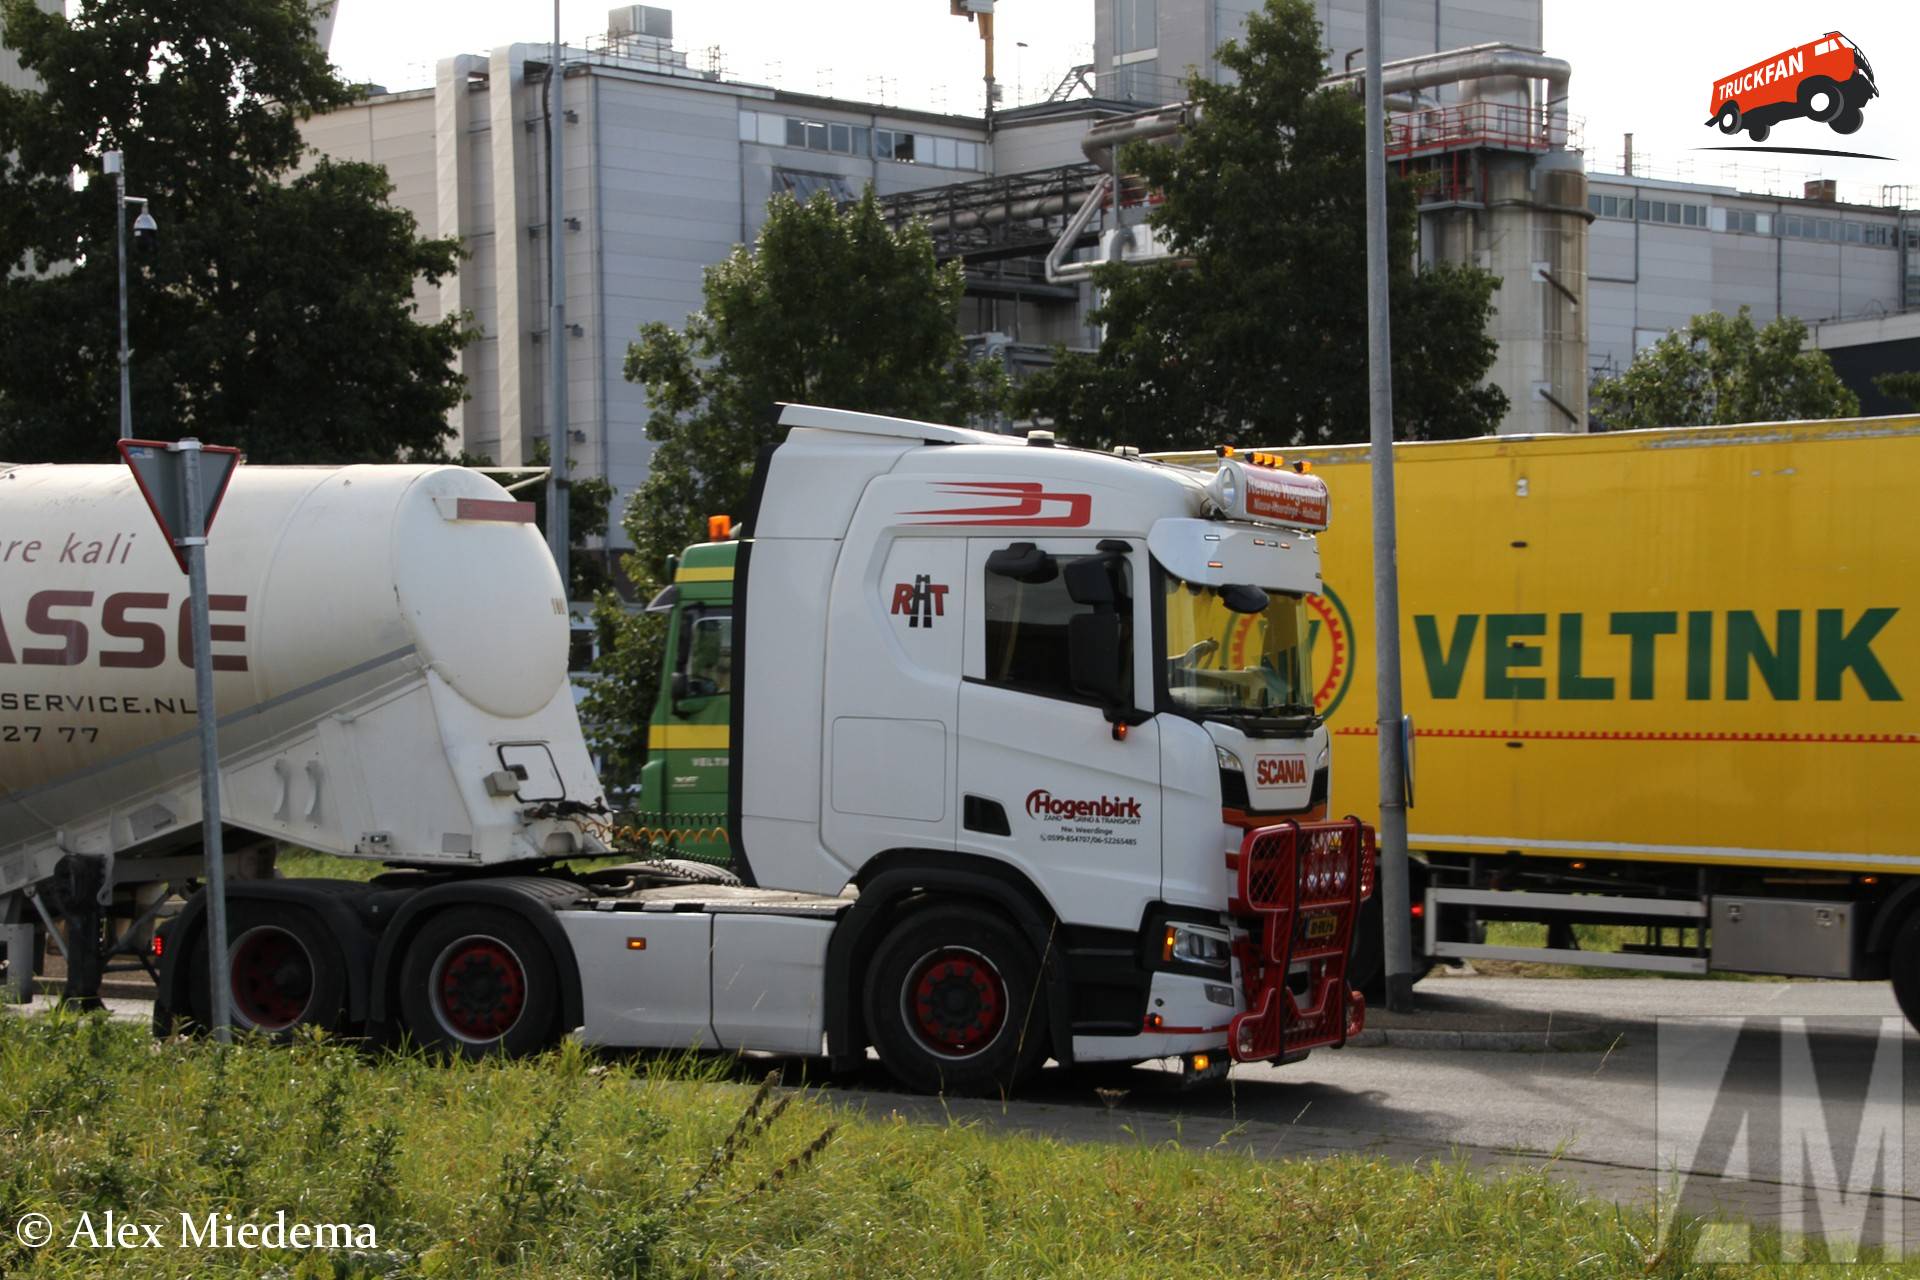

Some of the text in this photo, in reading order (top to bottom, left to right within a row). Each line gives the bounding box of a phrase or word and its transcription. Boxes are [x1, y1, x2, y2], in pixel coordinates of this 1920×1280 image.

[0, 532, 136, 564] re kali
[0, 589, 249, 672] SSE
[1413, 607, 1904, 702] VELTINK
[1, 693, 198, 714] SERVICE.NL
[58, 727, 99, 744] 77
[1257, 759, 1306, 785] SCANIA
[1034, 794, 1142, 819] Hogenbirk
[1101, 816, 1141, 825] TRANSPORT
